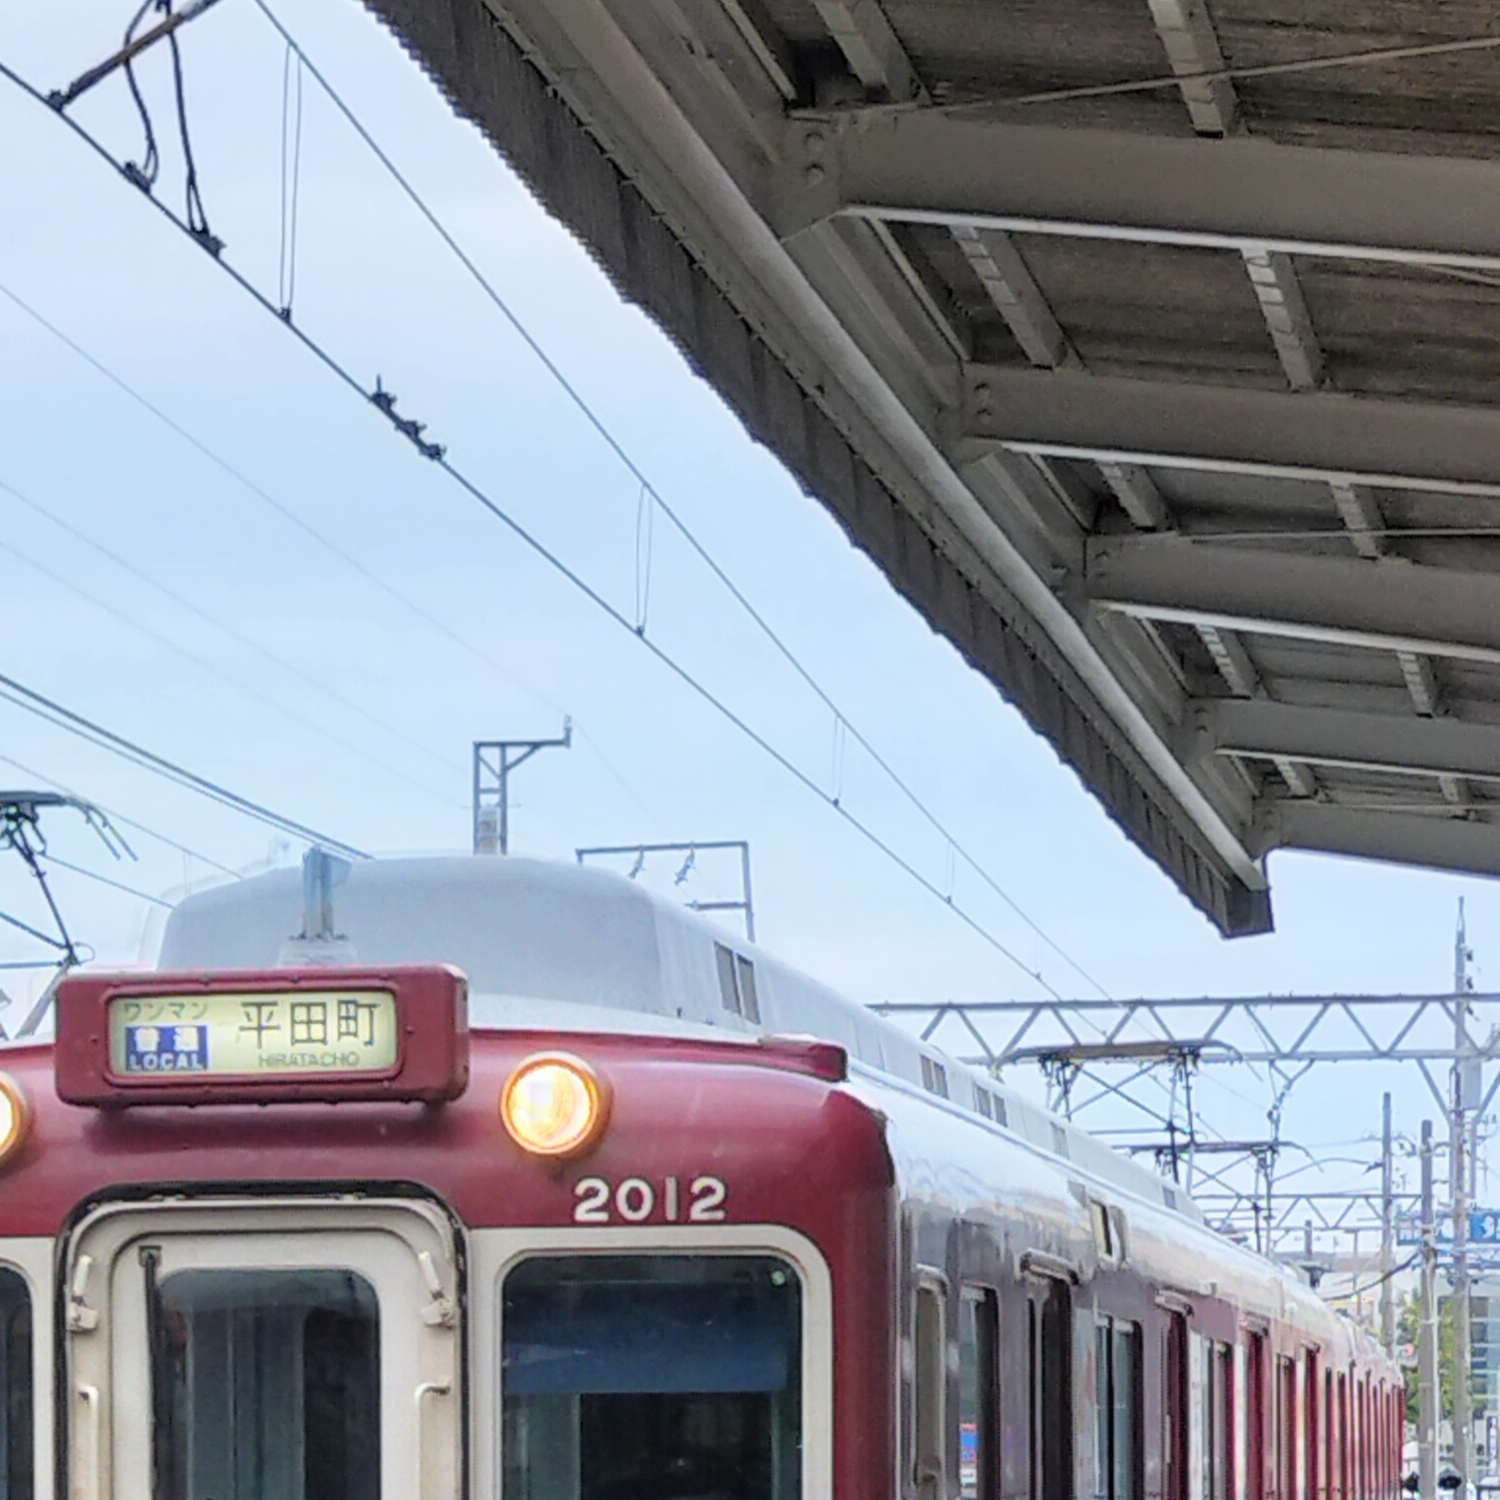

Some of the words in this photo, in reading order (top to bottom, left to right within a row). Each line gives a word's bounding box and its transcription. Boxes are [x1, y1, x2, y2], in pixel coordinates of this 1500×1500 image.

[124, 1001, 209, 1022] ワンマン
[238, 999, 379, 1049] 平田町
[129, 1053, 204, 1071] LOCAL
[258, 1051, 360, 1068] HIRATACHO
[574, 1175, 726, 1221] 2012
